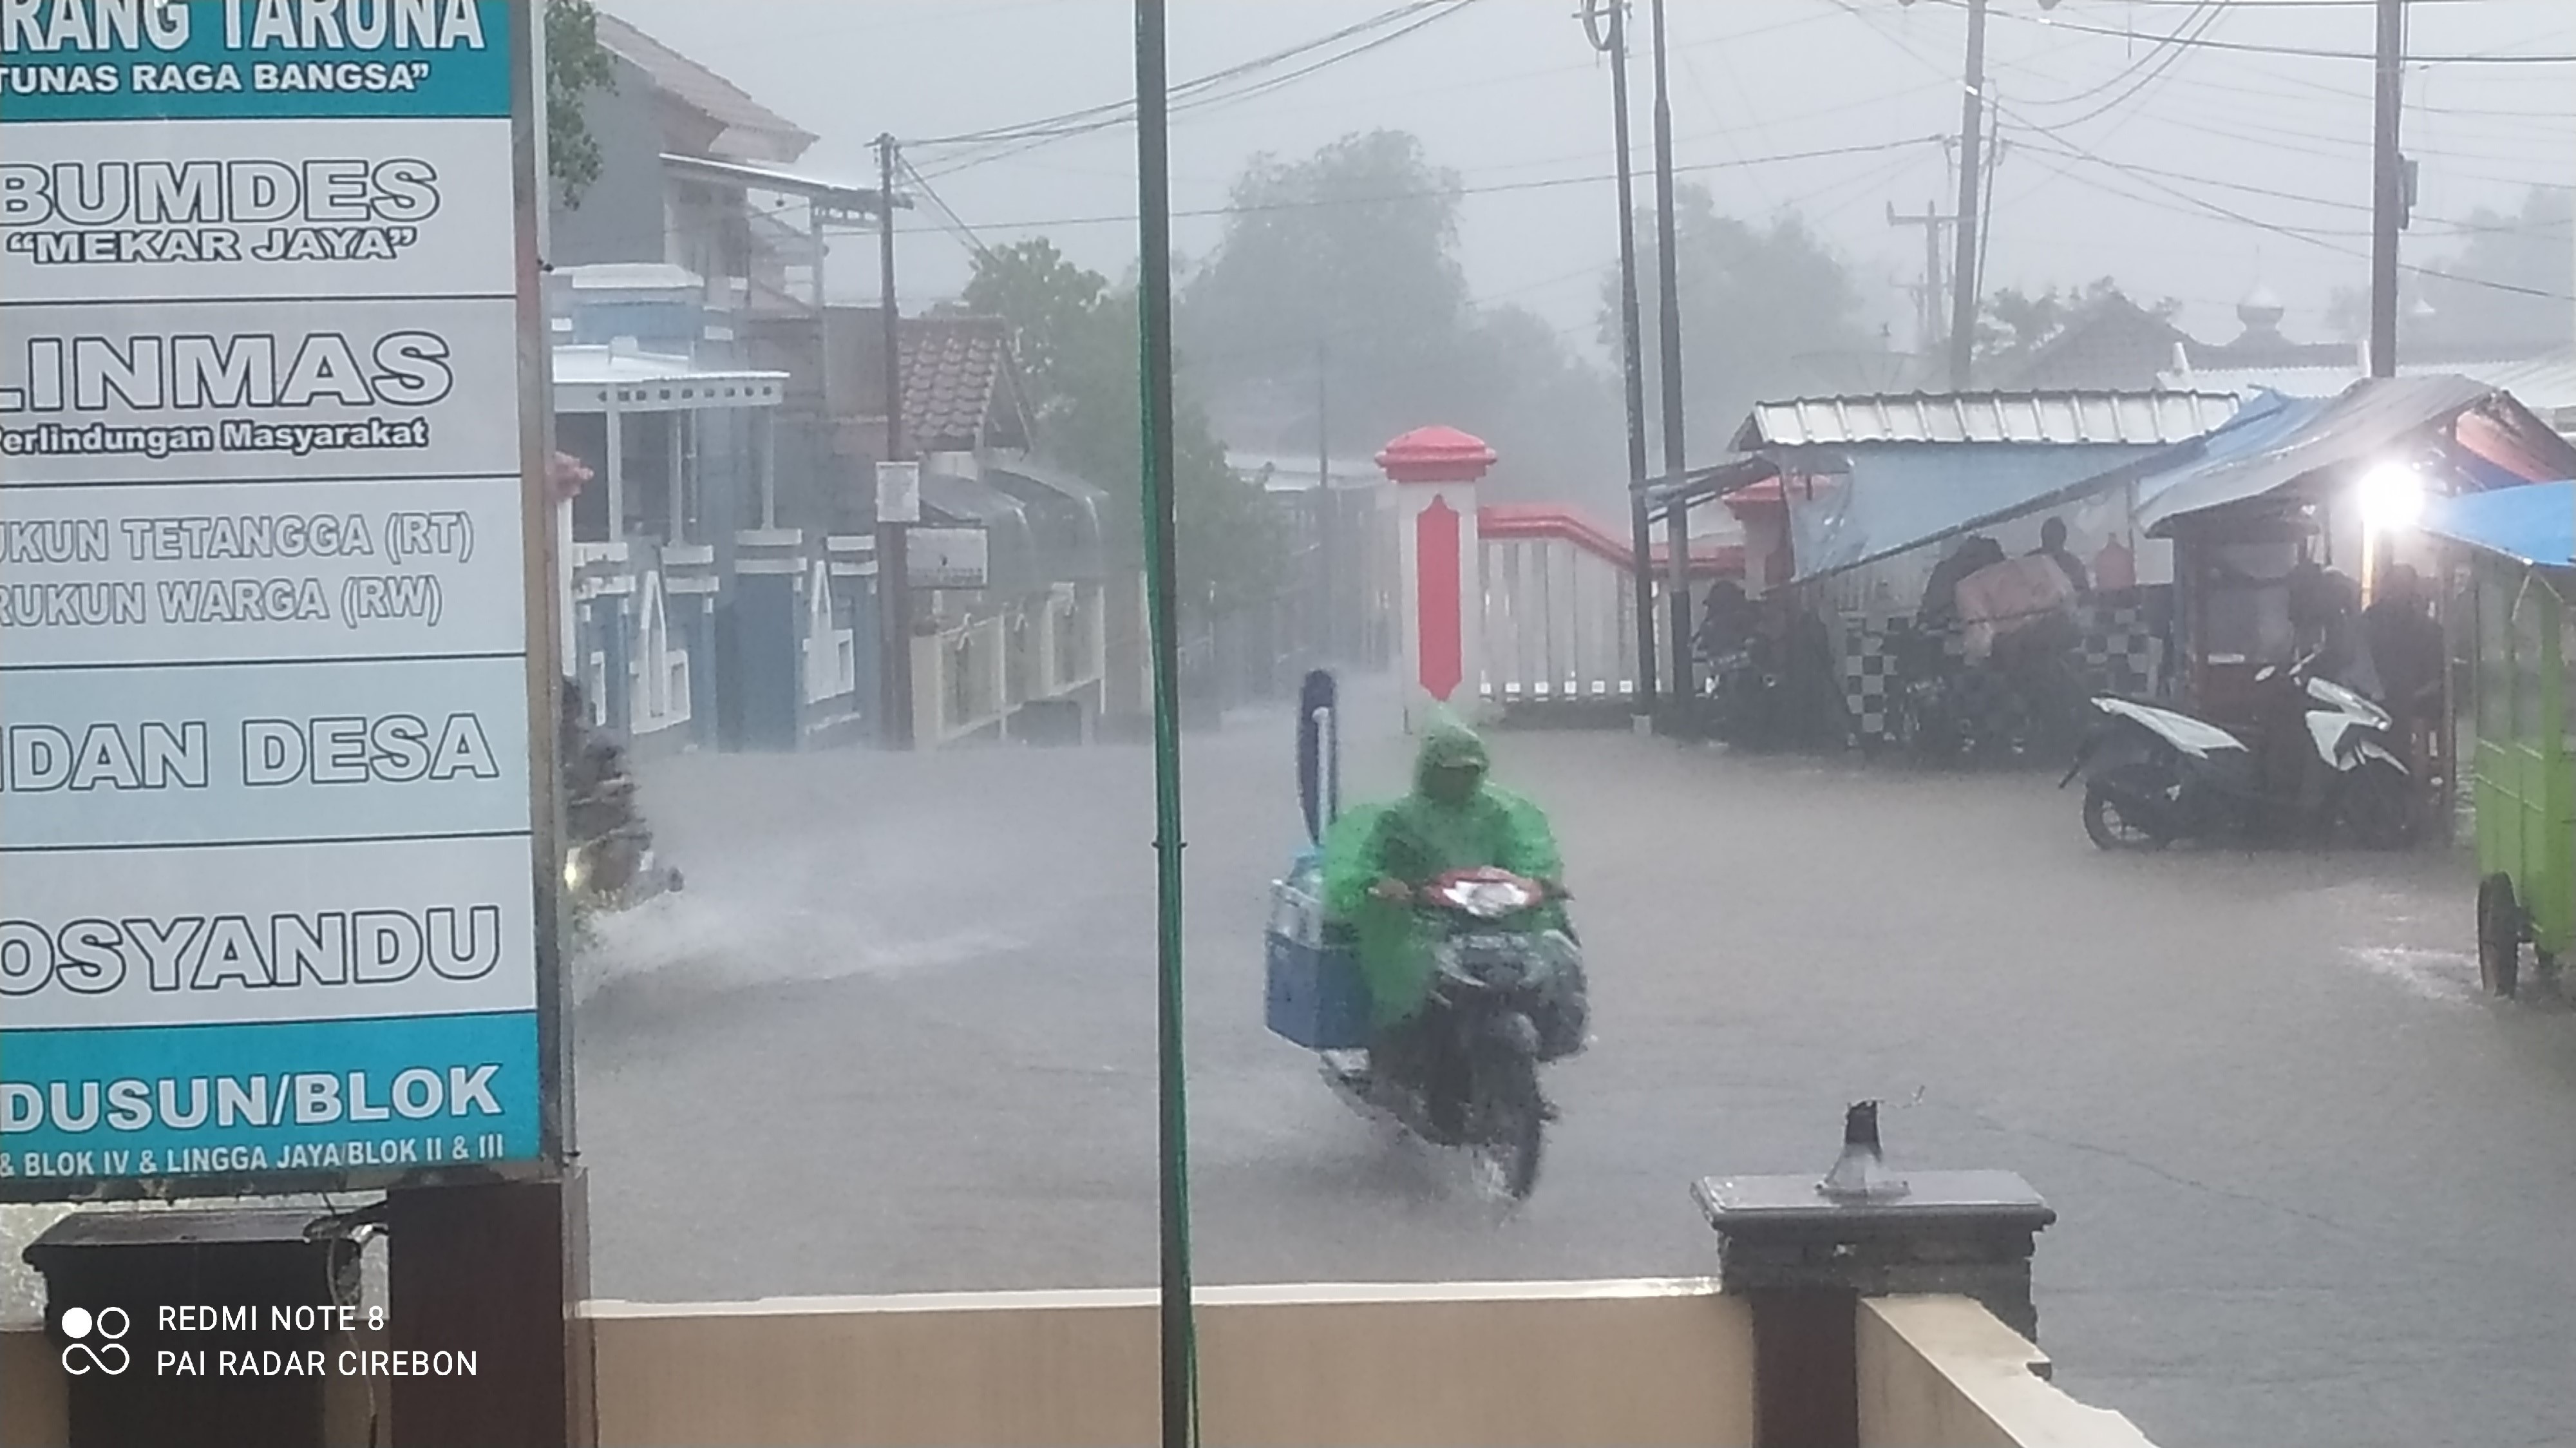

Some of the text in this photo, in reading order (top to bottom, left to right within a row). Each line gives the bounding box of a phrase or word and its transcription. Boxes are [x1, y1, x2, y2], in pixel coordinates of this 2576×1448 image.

[223, 0, 486, 52] TARUNA
[131, 64, 242, 93] RAGA
[0, 158, 440, 226] BUMDES
[0, 416, 430, 457] erlindungan Masyarakat
[0, 511, 475, 564] KUN TETANGGA (RT)
[157, 578, 330, 624] WARGA
[341, 575, 443, 628] (RW)
[0, 713, 499, 792] DAN DESA
[0, 1063, 504, 1134] DUSUN/BLOK
[24, 1150, 95, 1177] BLOK
[104, 1150, 130, 1176] IV
[138, 1148, 158, 1174] &
[167, 1146, 267, 1173] LINGGA
[426, 1136, 442, 1161] II
[452, 1134, 470, 1160] &
[479, 1133, 504, 1159] III
